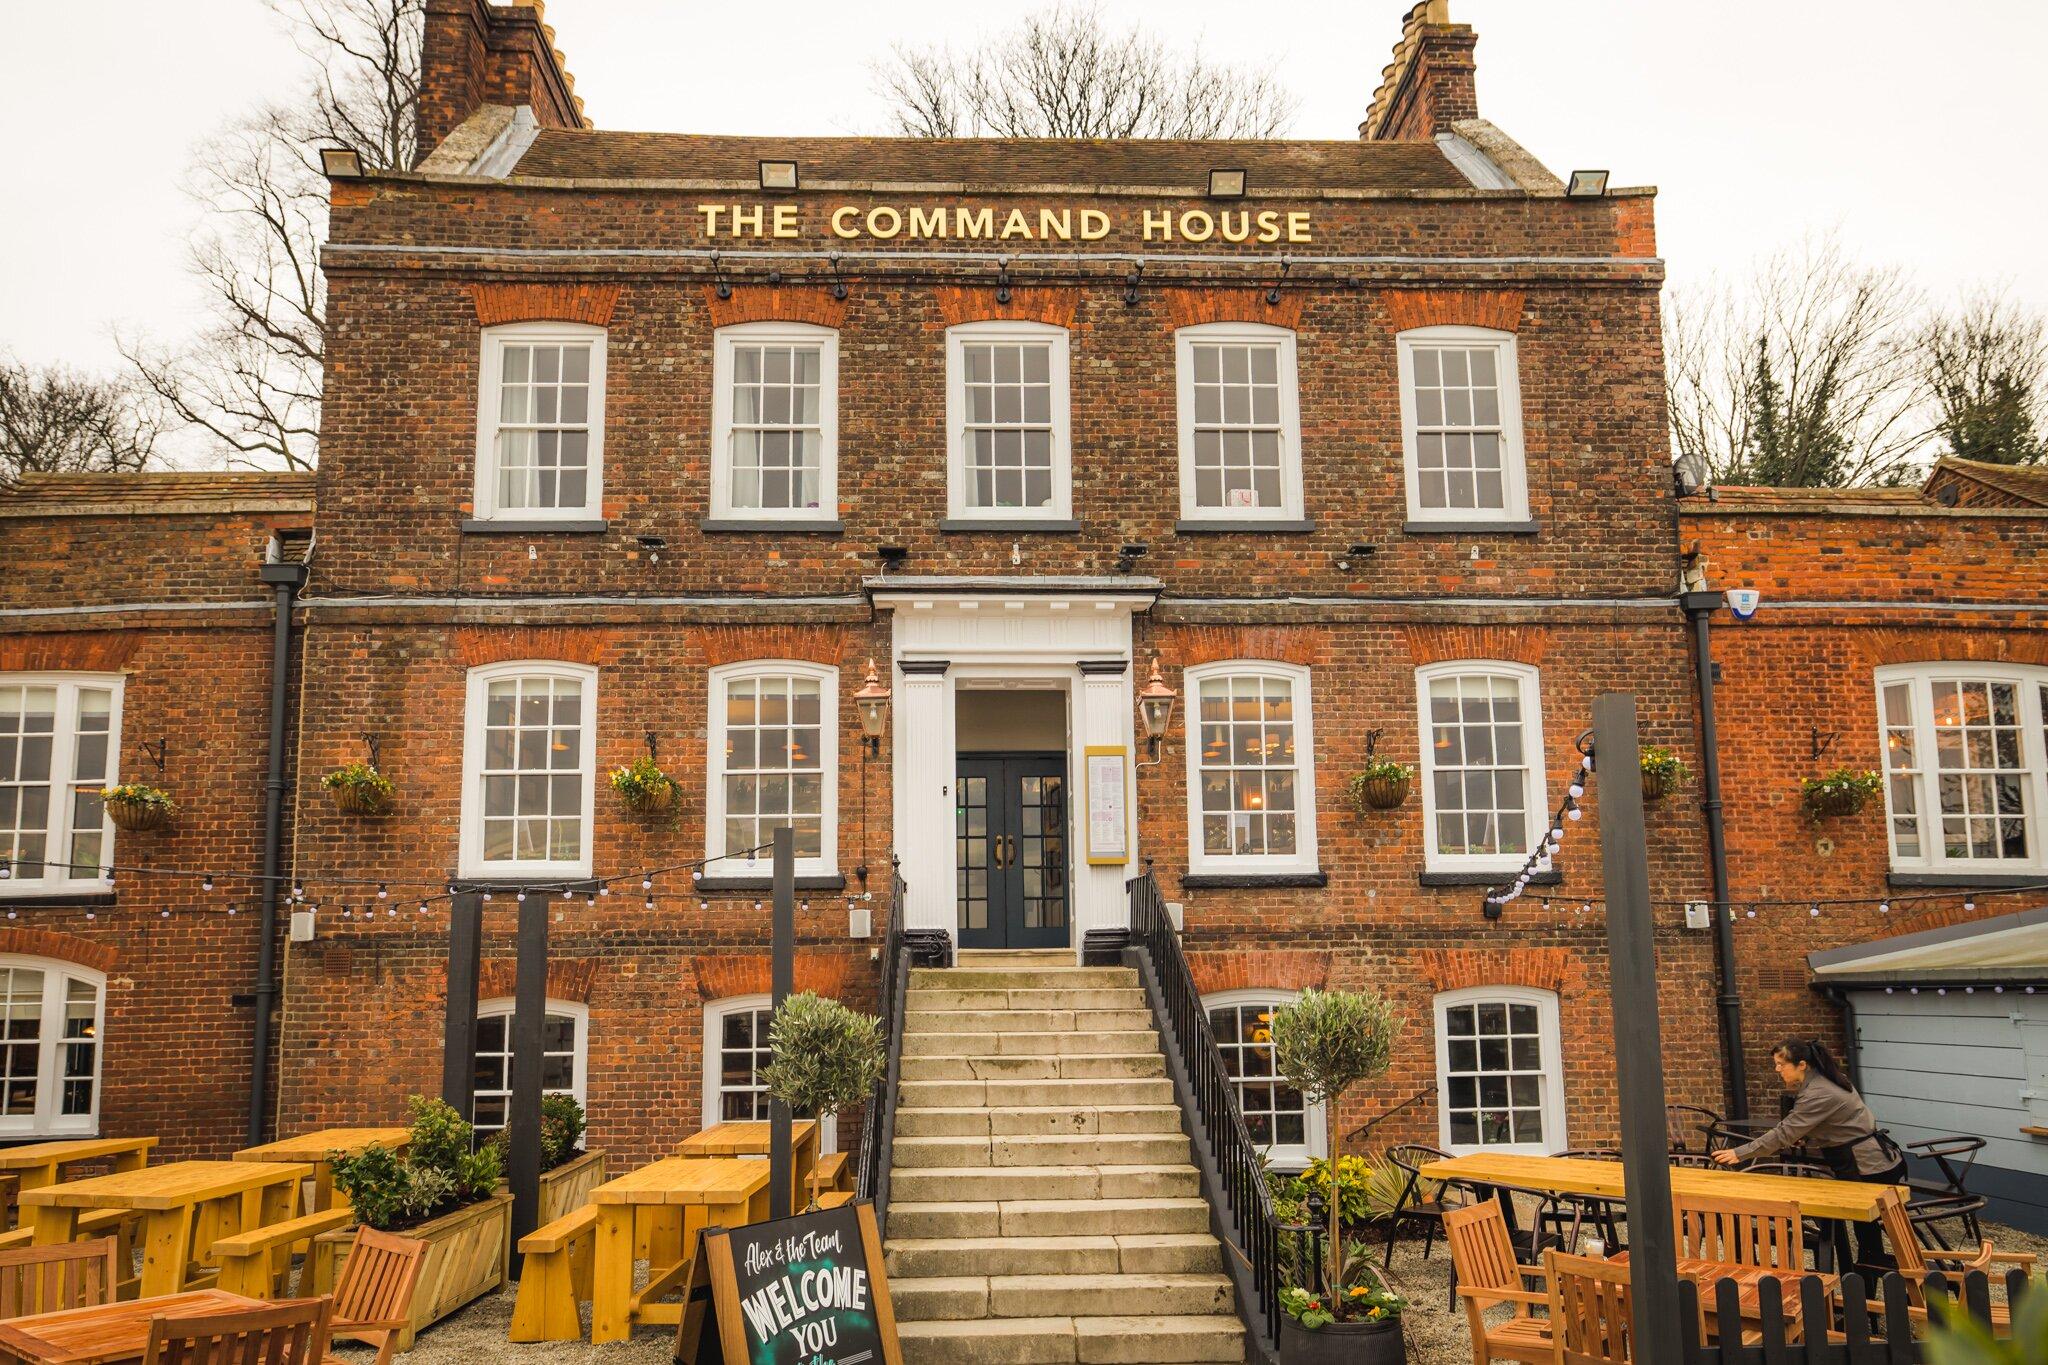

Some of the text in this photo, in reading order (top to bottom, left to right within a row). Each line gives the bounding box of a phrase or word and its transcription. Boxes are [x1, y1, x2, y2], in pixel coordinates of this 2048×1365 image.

[697, 203, 1312, 243] THE COMMAND HOUSE
[744, 1230, 843, 1276] Alex & the Team
[741, 1266, 866, 1344] WELCOME
[789, 1316, 838, 1358] YOU
